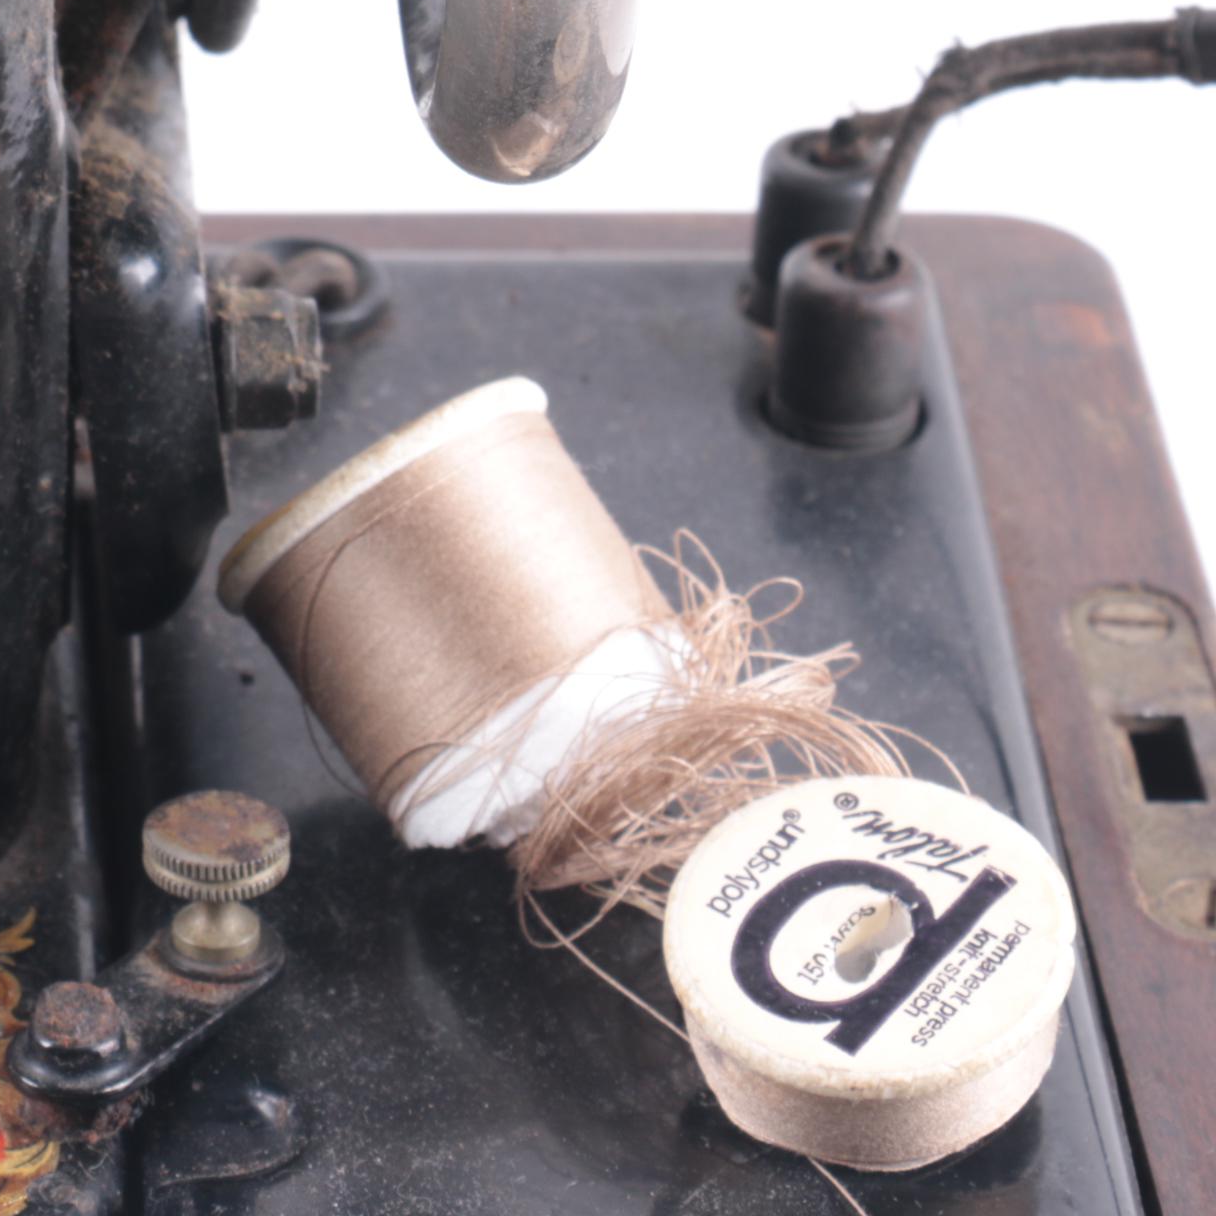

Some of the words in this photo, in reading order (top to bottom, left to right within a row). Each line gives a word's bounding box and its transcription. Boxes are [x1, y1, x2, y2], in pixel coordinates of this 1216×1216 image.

[904, 927, 999, 1019] knit-stretch
[956, 920, 1032, 1006] permanent
[910, 1000, 958, 1048] press
